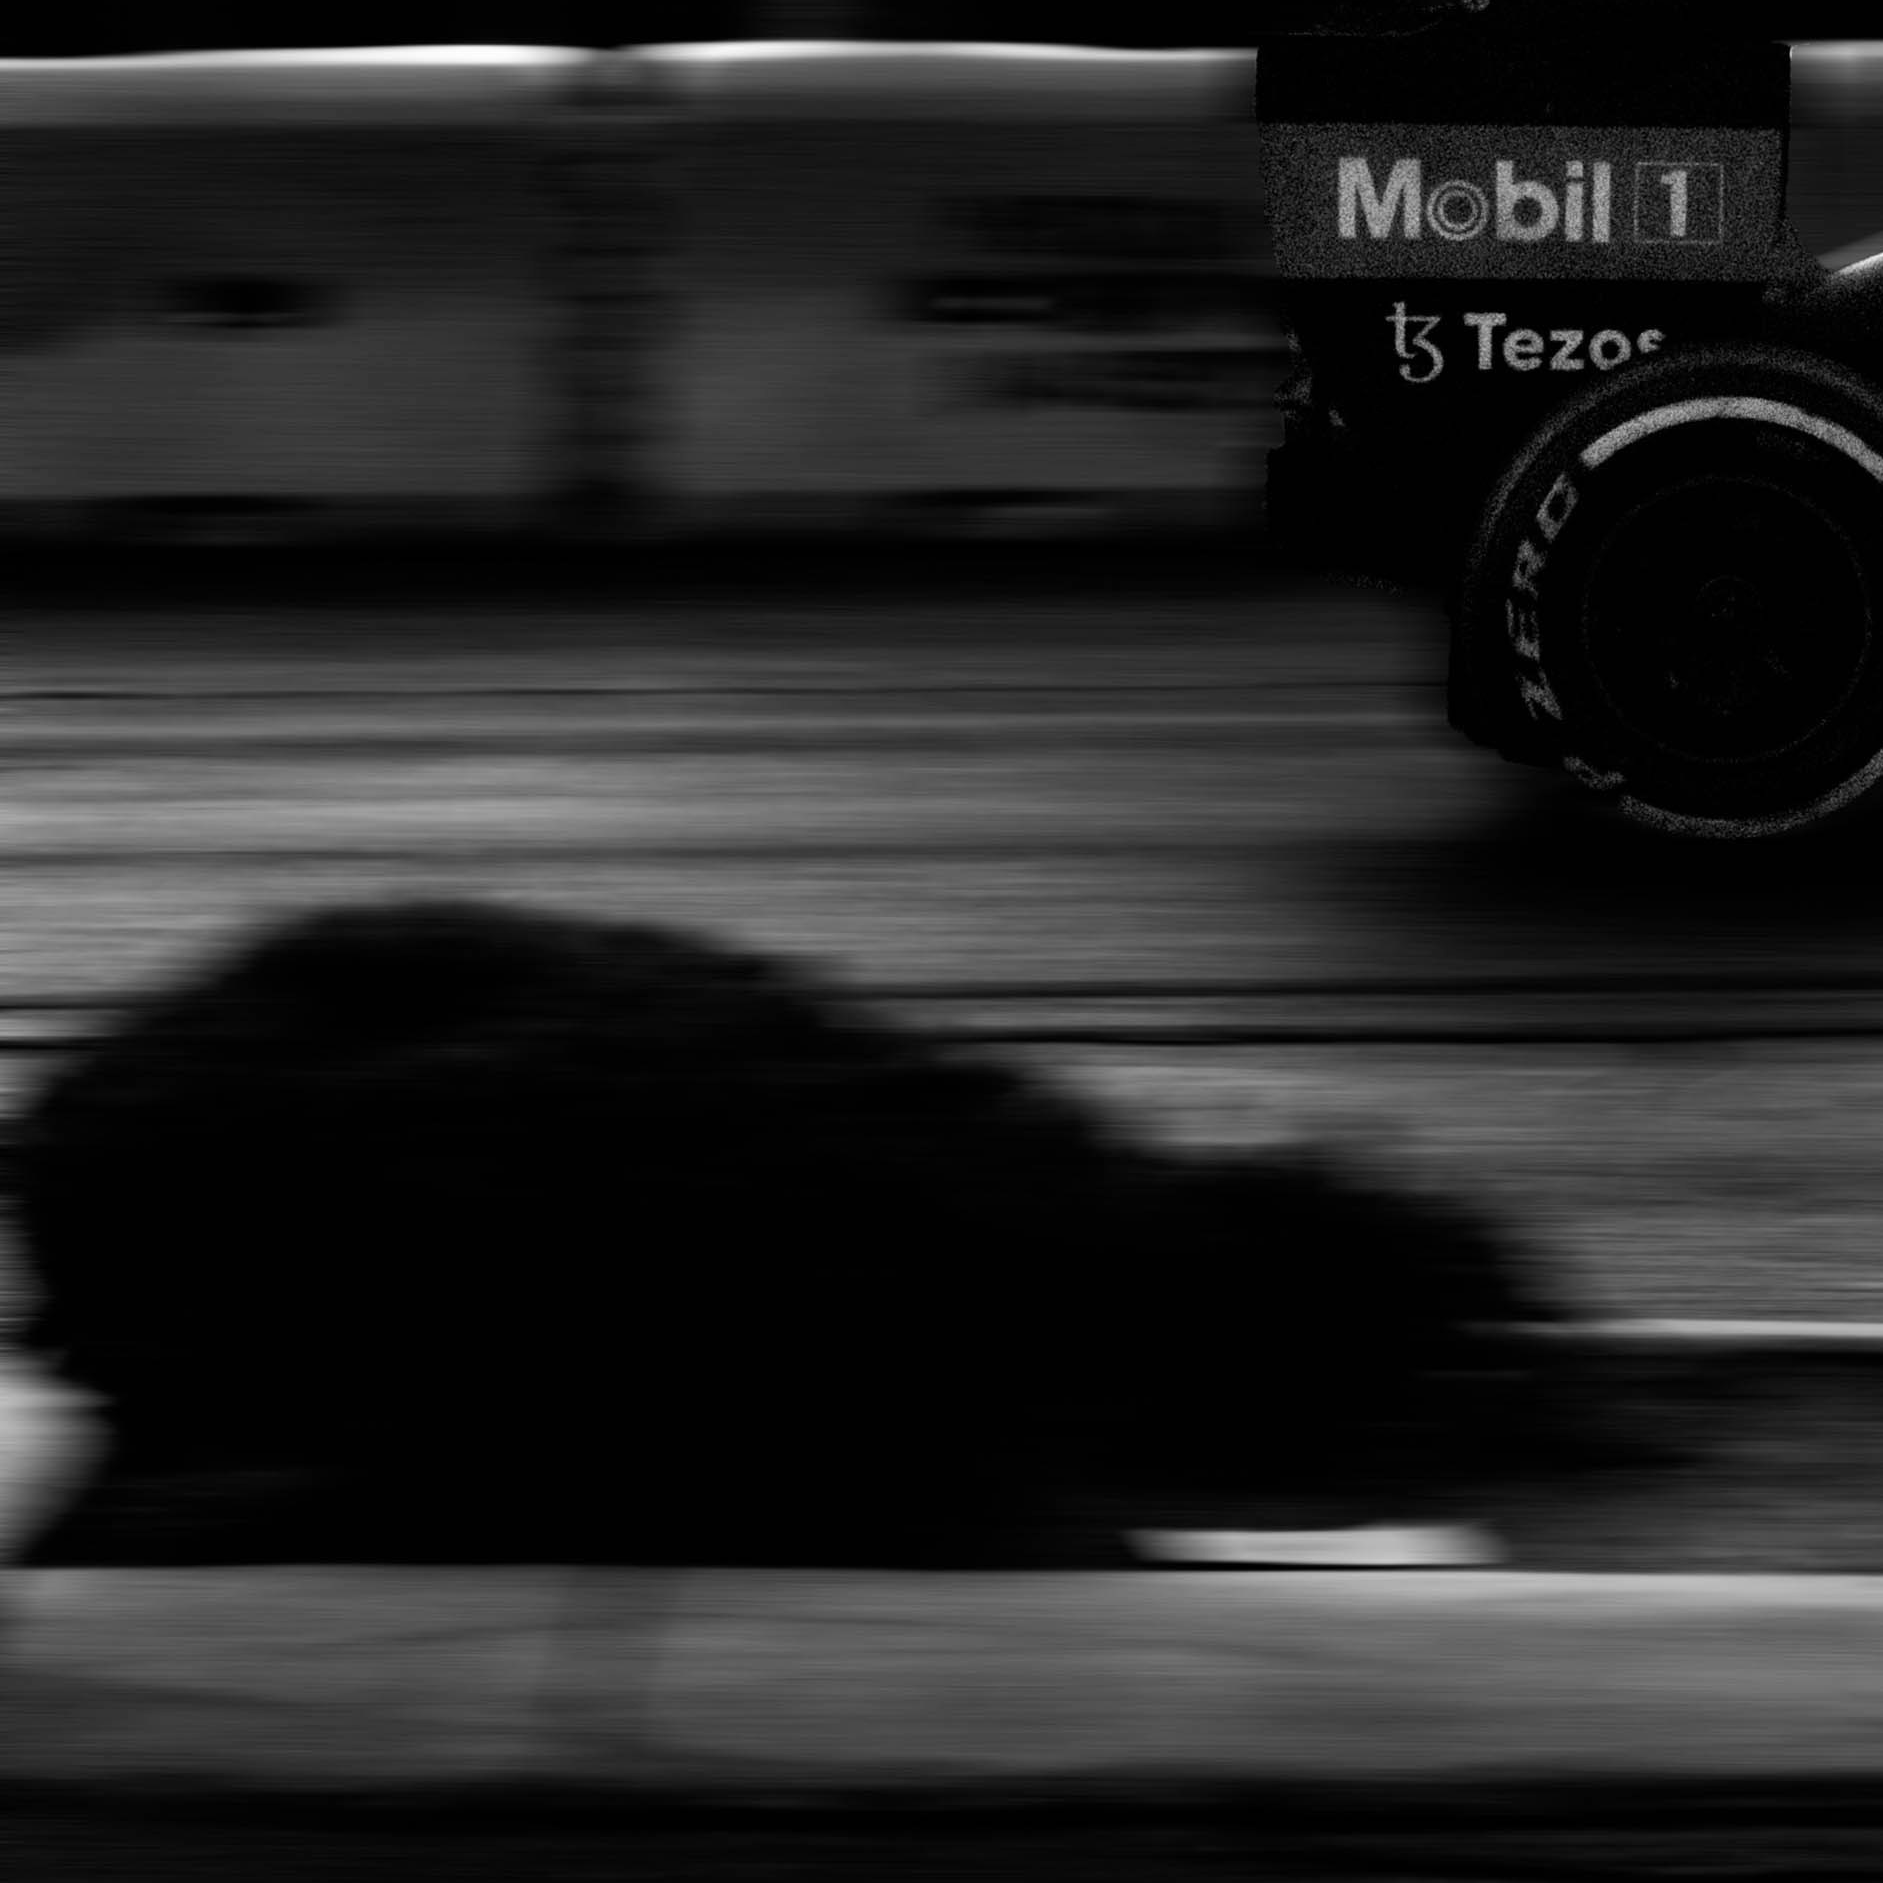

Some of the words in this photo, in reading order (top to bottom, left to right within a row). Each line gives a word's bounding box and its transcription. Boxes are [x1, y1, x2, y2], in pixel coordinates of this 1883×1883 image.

[1338, 157, 1611, 244] Mobil
[1659, 170, 1692, 238] 1
[1462, 311, 1667, 373] Tezos
